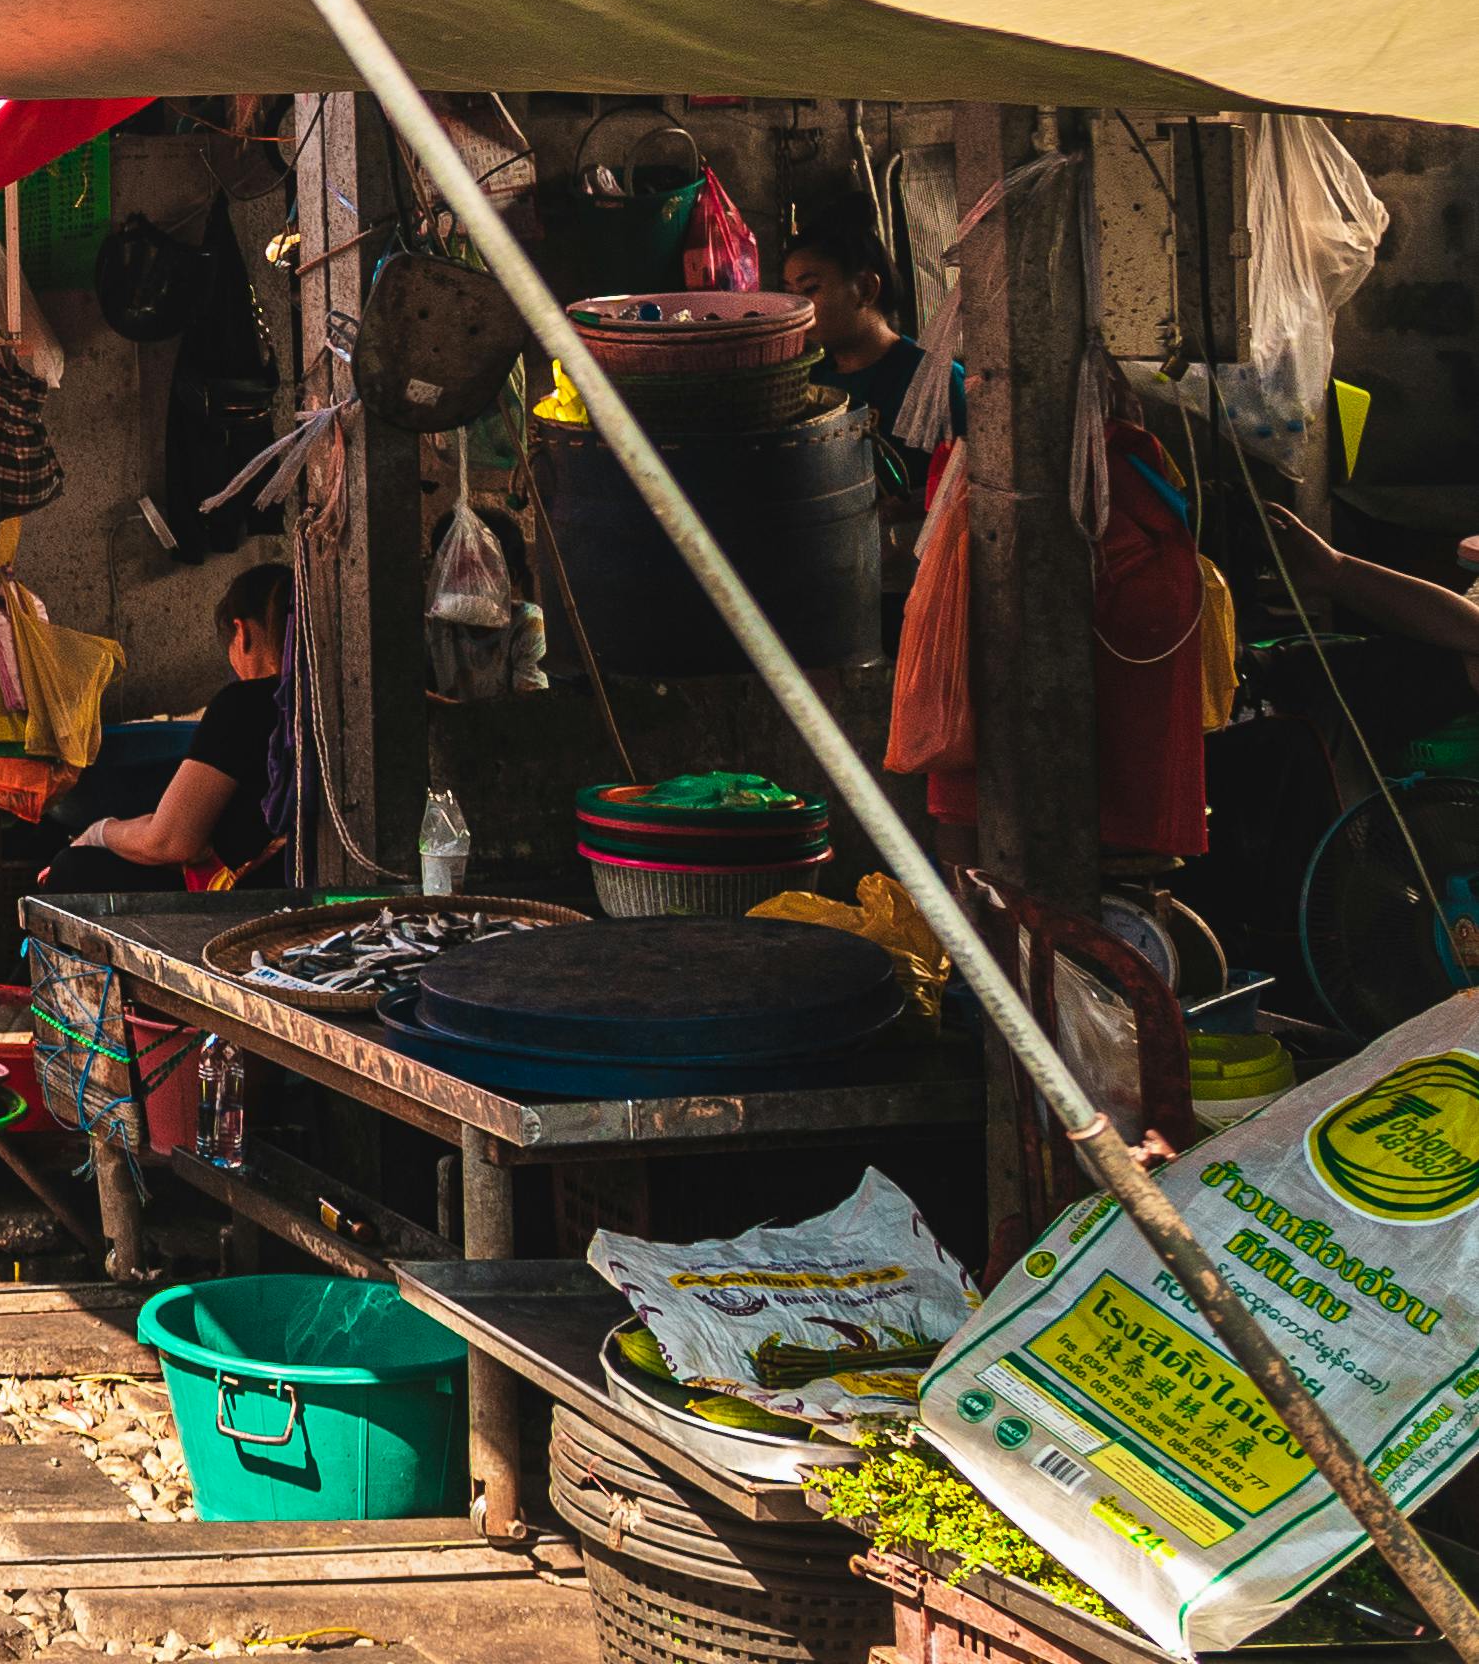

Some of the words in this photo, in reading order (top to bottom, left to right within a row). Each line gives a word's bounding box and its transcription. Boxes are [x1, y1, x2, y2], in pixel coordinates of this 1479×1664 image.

[1374, 1130, 1446, 1178] 481380
[1199, 1159, 1443, 1336] ข้าวเหลืองอ่อน
[1223, 1229, 1353, 1326] ดีพิเศษ
[1057, 1332, 1078, 1354] โทร.
[1078, 1351, 1108, 1377] (034)
[1190, 1435, 1220, 1459] (034)
[1219, 1454, 1269, 1490] 881-777
[1130, 1523, 1164, 1551] 24
